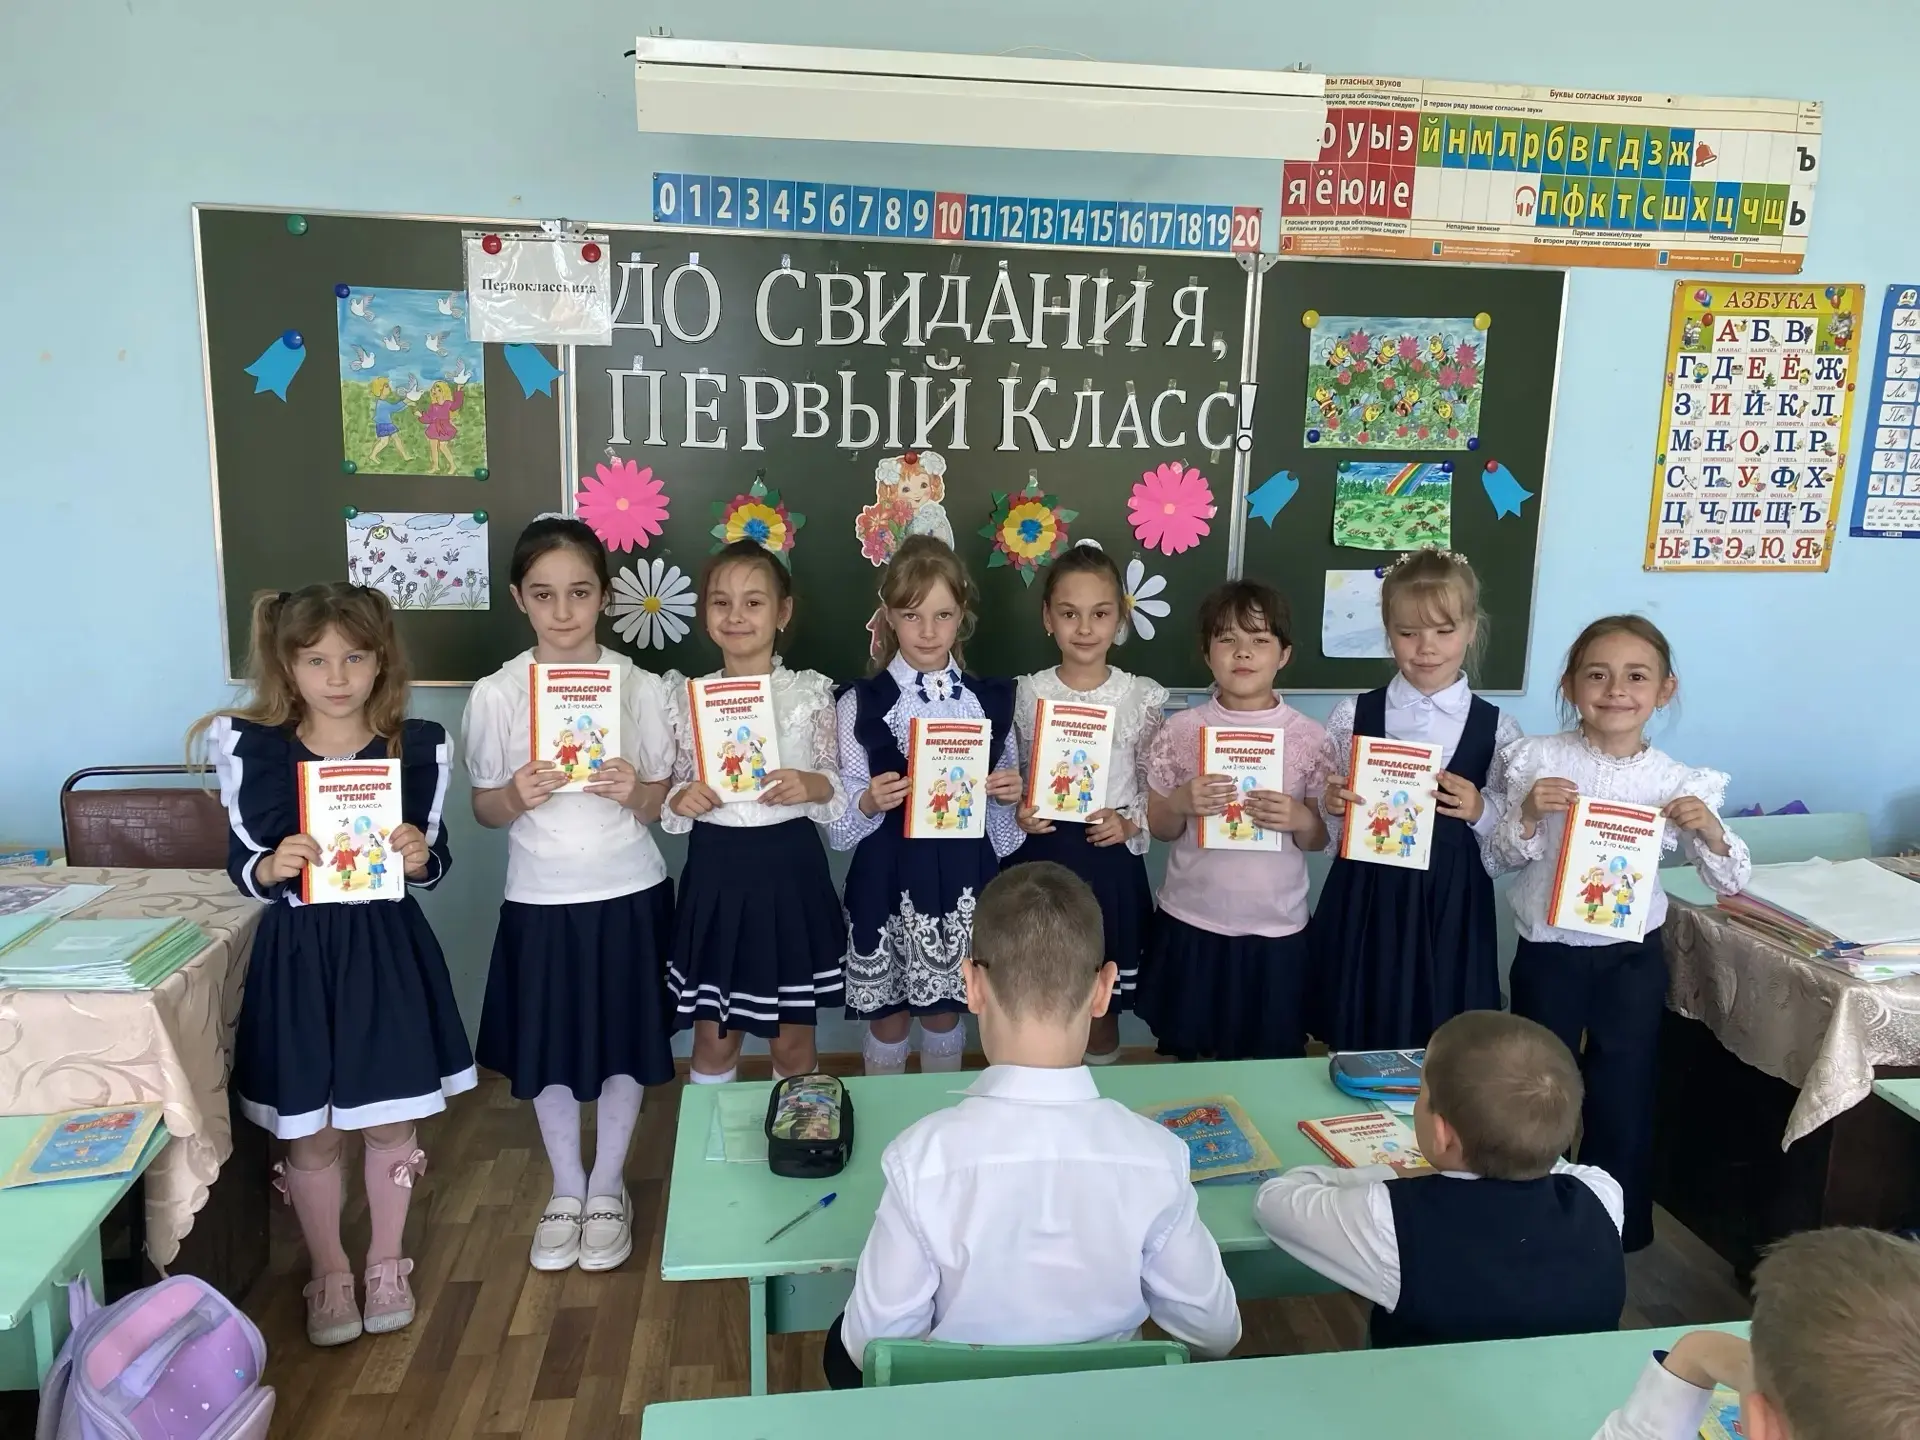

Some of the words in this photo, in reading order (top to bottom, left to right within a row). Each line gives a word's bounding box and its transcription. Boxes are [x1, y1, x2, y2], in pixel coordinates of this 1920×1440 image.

[1340, 78, 1373, 86] гласных
[1376, 79, 1402, 88] звуков
[1550, 89, 1574, 100] Буквы
[1575, 92, 1614, 102] согласных
[1616, 93, 1642, 103] звуков
[1429, 101, 1452, 109] первом
[1454, 102, 1468, 110] ряду
[660, 182, 676, 215] 0
[690, 184, 701, 217] 1
[717, 186, 732, 218] 2
[746, 187, 760, 220] 3
[773, 190, 790, 222] 4
[802, 191, 817, 224] 5
[830, 194, 846, 226] 6
[858, 195, 874, 228] 7
[885, 198, 901, 230] 8
[912, 200, 929, 232] 9
[938, 202, 962, 235] 10
[970, 204, 992, 236] 11
[1000, 206, 1023, 238] 12
[1030, 207, 1054, 240] 13
[1060, 208, 1085, 241] 14
[1090, 210, 1114, 242] 15
[1120, 210, 1144, 244] 16
[1150, 212, 1173, 244] 17
[1178, 212, 1202, 246] 18
[1207, 213, 1231, 246] 19
[1234, 215, 1260, 248] 20
[1351, 219, 1384, 227] обозначают
[1446, 223, 1475, 232] Непарные
[1572, 230, 1596, 238] Парные
[1596, 231, 1643, 239] звонкие/глухие
[1708, 234, 1738, 242] Непарные
[1542, 238, 1565, 246] втором
[1602, 240, 1632, 248] согласные
[611, 262, 721, 347] ДО
[1724, 290, 1818, 310] АЗБУКА
[1716, 319, 1739, 342] А
[1750, 320, 1770, 342] Б
[1785, 320, 1804, 342] В
[1678, 356, 1696, 378] Г
[1712, 356, 1734, 384] Д
[1747, 357, 1766, 380] Е
[1781, 354, 1800, 380] Ё
[1815, 358, 1843, 380] Ж
[605, 354, 973, 451] ПЕРВЫЙ
[995, 377, 1260, 452] КЛАСС!
[1674, 393, 1691, 415] З
[1708, 394, 1732, 416] И
[1743, 390, 1766, 416] Й
[1777, 394, 1798, 416] К
[1812, 394, 1835, 416] Л
[1670, 430, 1693, 451] М
[1704, 430, 1728, 452] Н
[1740, 430, 1758, 452] О
[1774, 430, 1798, 452] П
[1808, 430, 1828, 452] Р
[1667, 466, 1685, 488] С
[1703, 466, 1721, 488] Т
[1738, 466, 1758, 488] У
[1770, 466, 1794, 488] Ф
[1804, 467, 1828, 488] Х
[1662, 502, 1687, 528] Ц
[1700, 502, 1719, 523] Ч
[1730, 502, 1758, 523] Ш
[1764, 502, 1792, 528] Щ
[1800, 502, 1821, 523] Ъ
[1658, 538, 1681, 558] Ы
[1692, 538, 1710, 558] Ь
[1725, 537, 1743, 558] Э
[1759, 537, 1784, 558] Ю
[1792, 538, 1815, 559] Я
[547, 685, 612, 693] ВНЕКЛАССНОЕ
[562, 694, 598, 702] ЧТЕНИЕ
[706, 696, 764, 708] ВНЕКЛАССНОЕ
[720, 706, 752, 714] ЧТЕНИЕ
[1051, 720, 1108, 732] ВНЕКЛАССНОЕ
[1063, 730, 1094, 738] ЧТЕНИЕ
[926, 738, 984, 746] ВНЕКЛАССНОЕ
[1215, 747, 1276, 756] ВНЕКЛАССНОЕ
[1368, 758, 1432, 772] ВНЕКЛАССНОЕ
[1381, 768, 1416, 779] ЧТЕНИЕ
[318, 782, 392, 794] ВНЕКЛАССНОЕ
[336, 792, 376, 802] ЧТЕНИЕ
[1585, 819, 1655, 837] ВНЕКЛАССНОЕ
[1599, 830, 1638, 844] ЧТЕНИЕ
